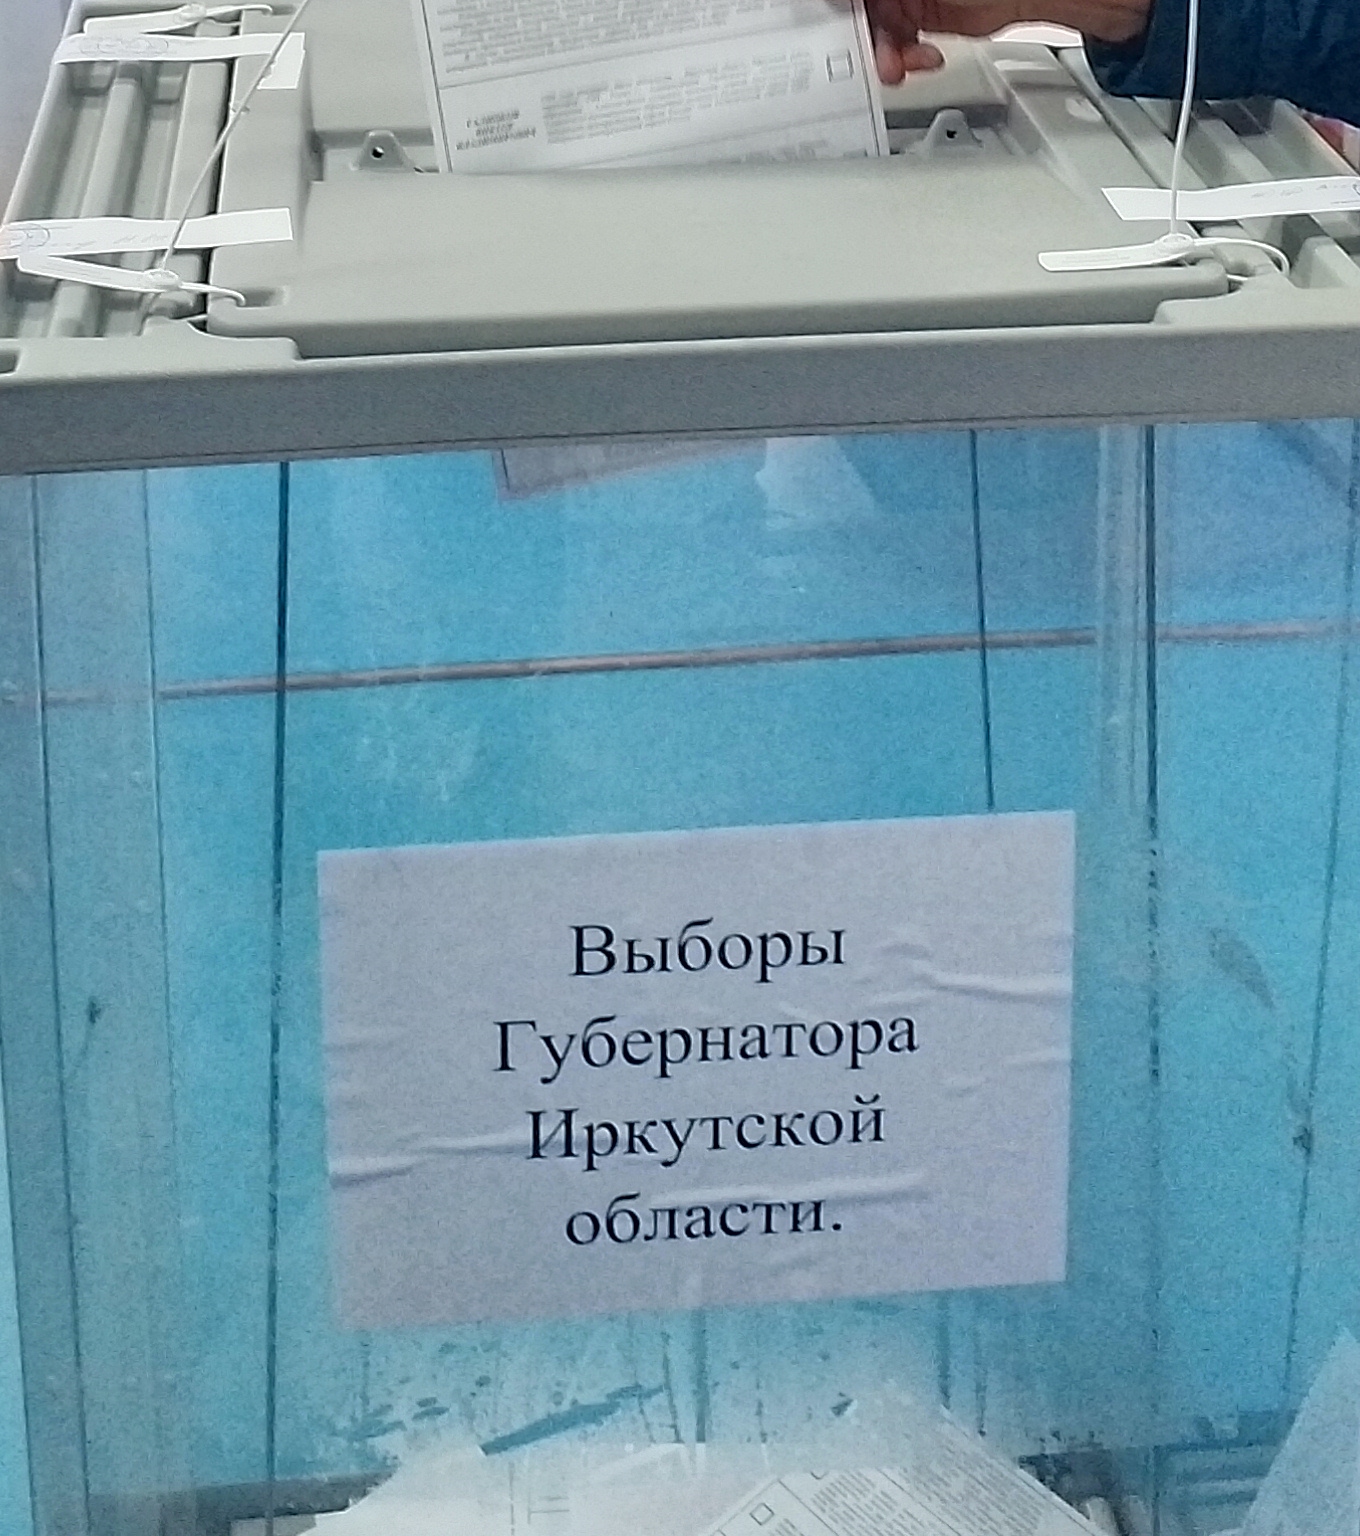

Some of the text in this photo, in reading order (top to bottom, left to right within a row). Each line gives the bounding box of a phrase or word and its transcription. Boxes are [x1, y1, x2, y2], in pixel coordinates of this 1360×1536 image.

[569, 918, 846, 983] Выборы
[492, 1014, 920, 1084] Губернатора
[525, 1094, 886, 1171] Иркутской
[565, 1192, 843, 1245] области.
